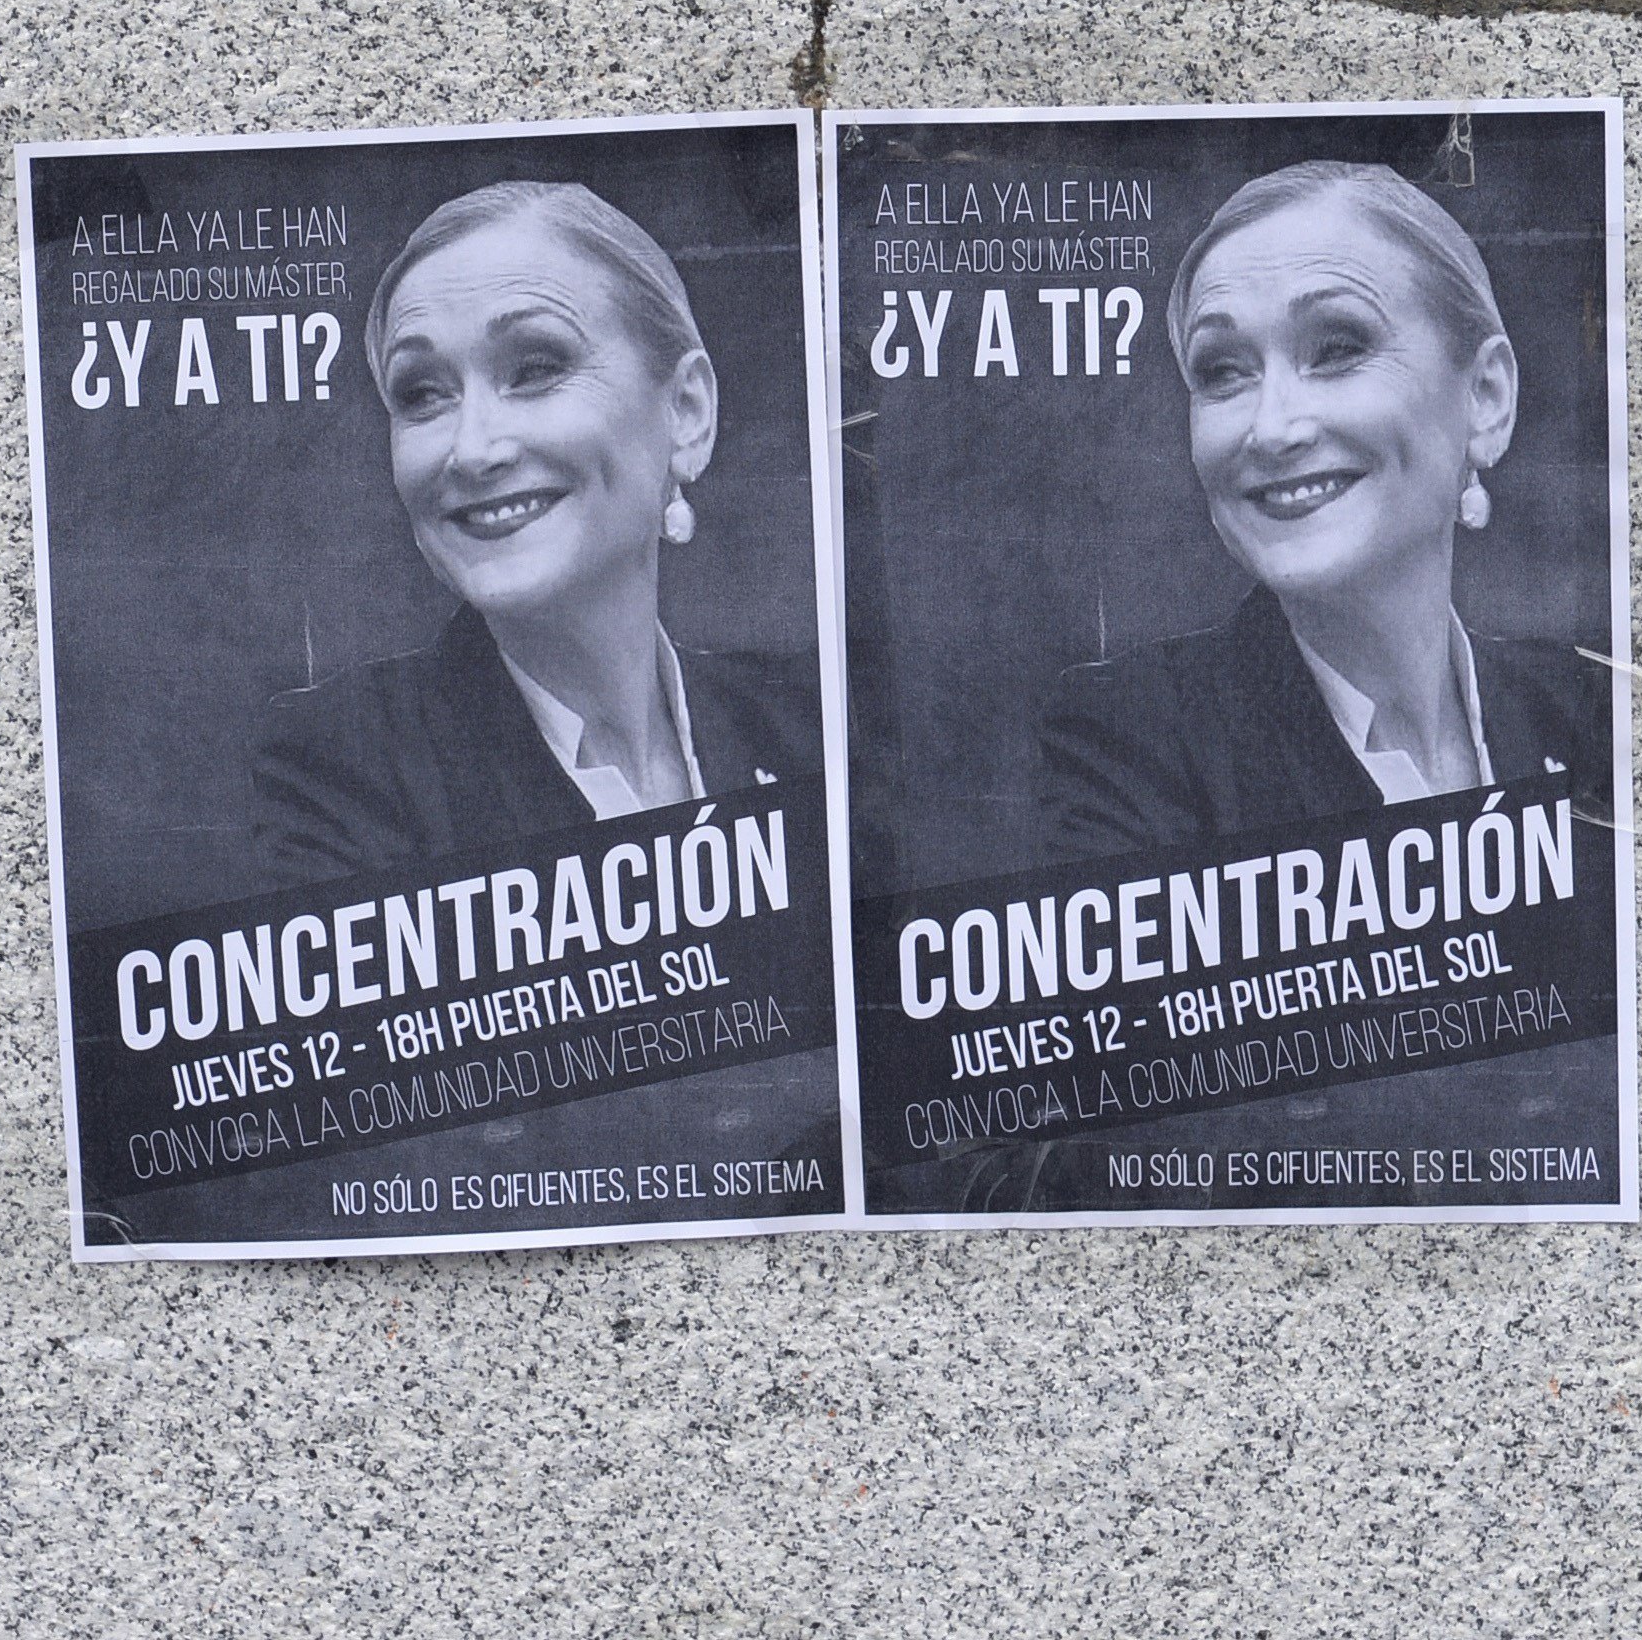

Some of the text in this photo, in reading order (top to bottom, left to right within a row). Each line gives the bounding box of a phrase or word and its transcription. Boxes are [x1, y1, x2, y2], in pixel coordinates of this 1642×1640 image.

[72, 205, 347, 256] A ELLA YA LE HAN
[875, 179, 1152, 224] A ELLA YA LE HAN
[72, 256, 353, 305] REGALADO SU MÁSTER,
[875, 230, 1156, 277] REGALADO SU MÁSTER,
[71, 312, 342, 410] ¿Y A TI?
[870, 286, 1144, 378] ¿Y A TI?
[116, 803, 789, 1051] CONCENTRACIÓN
[898, 790, 1574, 1020] CONCENTRACIÓN
[172, 1041, 295, 1111] JUEVES
[302, 1031, 346, 1080] 12
[376, 1009, 445, 1062] 18H
[448, 975, 585, 1048] PUERTA
[588, 960, 657, 1014] DEL
[660, 942, 730, 997] SOL
[951, 1015, 1074, 1080] JUEVES
[1082, 1005, 1126, 1053] 12
[1158, 985, 1225, 1039] 18H
[1230, 958, 1366, 1026] PUERTA
[1370, 945, 1439, 997] DEL
[1444, 930, 1512, 983] SOL
[128, 995, 791, 1179] CONVOCA LA COMUNIDAD UNIVERSITARIA
[905, 983, 1571, 1149] CONVOCA LA COMUNIDAD UNIVERSITARIA
[332, 1158, 824, 1216] NO SÓLO ES CIFUENTES, ES EL SISTEMA
[1108, 1146, 1601, 1188] NO SÓLO ES CIFUENTES, ES EL SISTEMA
